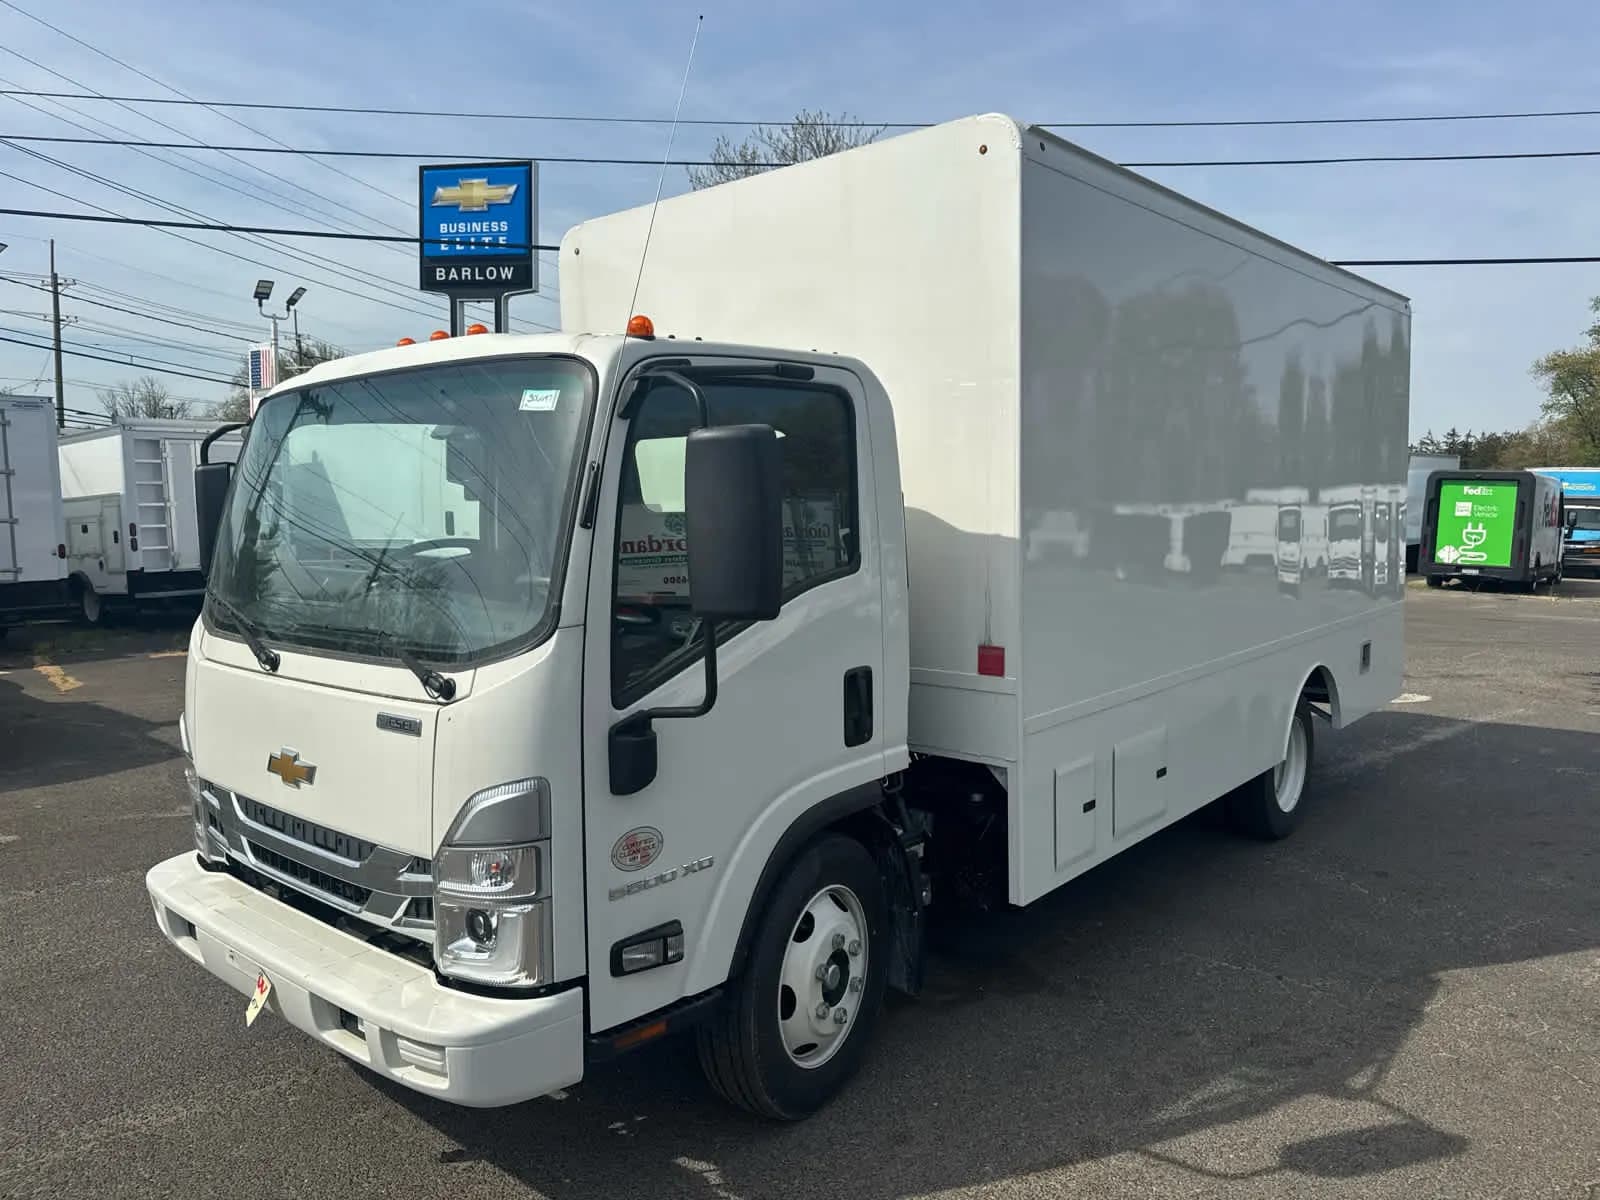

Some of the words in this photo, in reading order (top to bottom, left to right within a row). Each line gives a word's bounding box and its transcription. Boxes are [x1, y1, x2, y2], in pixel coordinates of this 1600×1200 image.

[440, 221, 508, 233] BUSINESS
[440, 236, 507, 250] ELITE
[436, 266, 513, 280] BARLOW
[1463, 486, 1493, 496] FedEx
